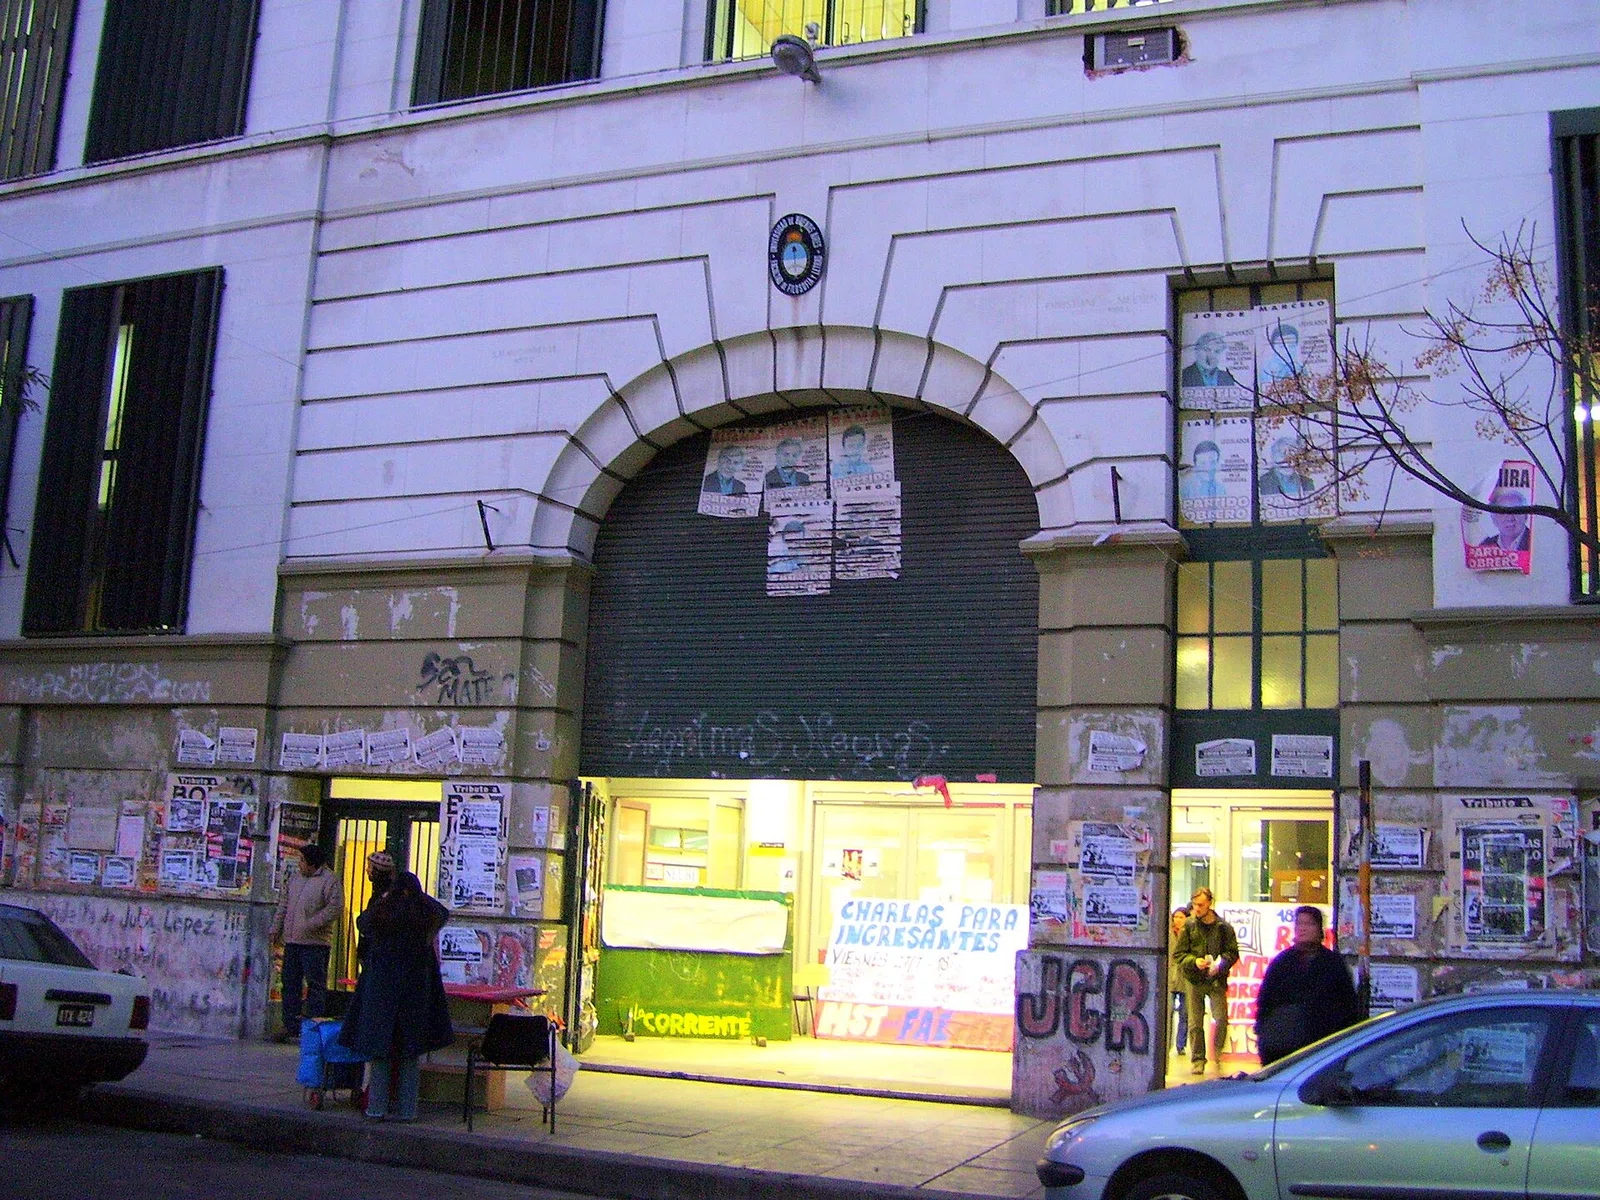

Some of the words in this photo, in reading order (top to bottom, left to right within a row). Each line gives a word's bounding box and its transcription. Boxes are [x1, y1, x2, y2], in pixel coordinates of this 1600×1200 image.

[1259, 300, 1325, 312] MARCELO
[1183, 388, 1253, 401] PARTIDO
[845, 483, 892, 493] JORGE
[702, 495, 759, 506] PARTIDO
[775, 500, 830, 508] MARCELO
[1183, 496, 1250, 510] PARTIDO
[1464, 799, 1516, 808] Tribute
[841, 901, 945, 929] CHARLAS
[958, 905, 1019, 931] PARA
[835, 923, 1001, 953] INGRESANTES
[643, 1011, 753, 1036] CORRIENTE
